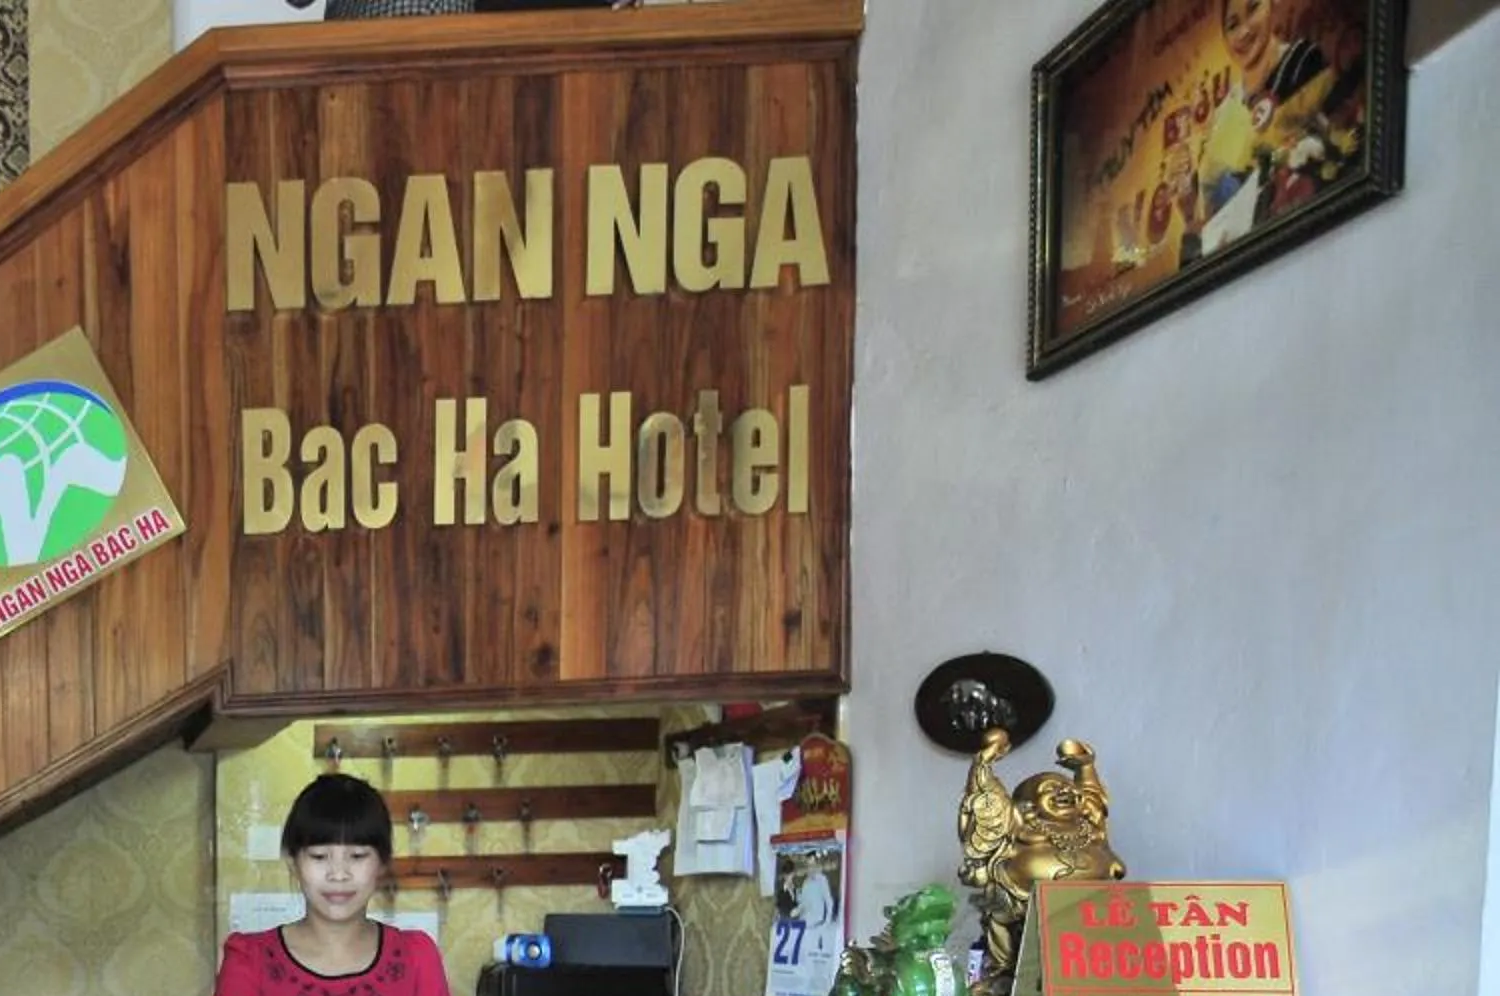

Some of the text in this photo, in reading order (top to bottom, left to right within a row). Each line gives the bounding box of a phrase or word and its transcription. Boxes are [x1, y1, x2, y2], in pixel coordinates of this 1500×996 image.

[225, 156, 830, 312] NGAN NGA
[241, 384, 810, 536] Bac Ha Hotel
[45, 552, 92, 593] NGA
[91, 527, 136, 567] BAC
[135, 508, 170, 541] HA
[773, 919, 807, 966] 27
[1058, 931, 1280, 984] Reception
